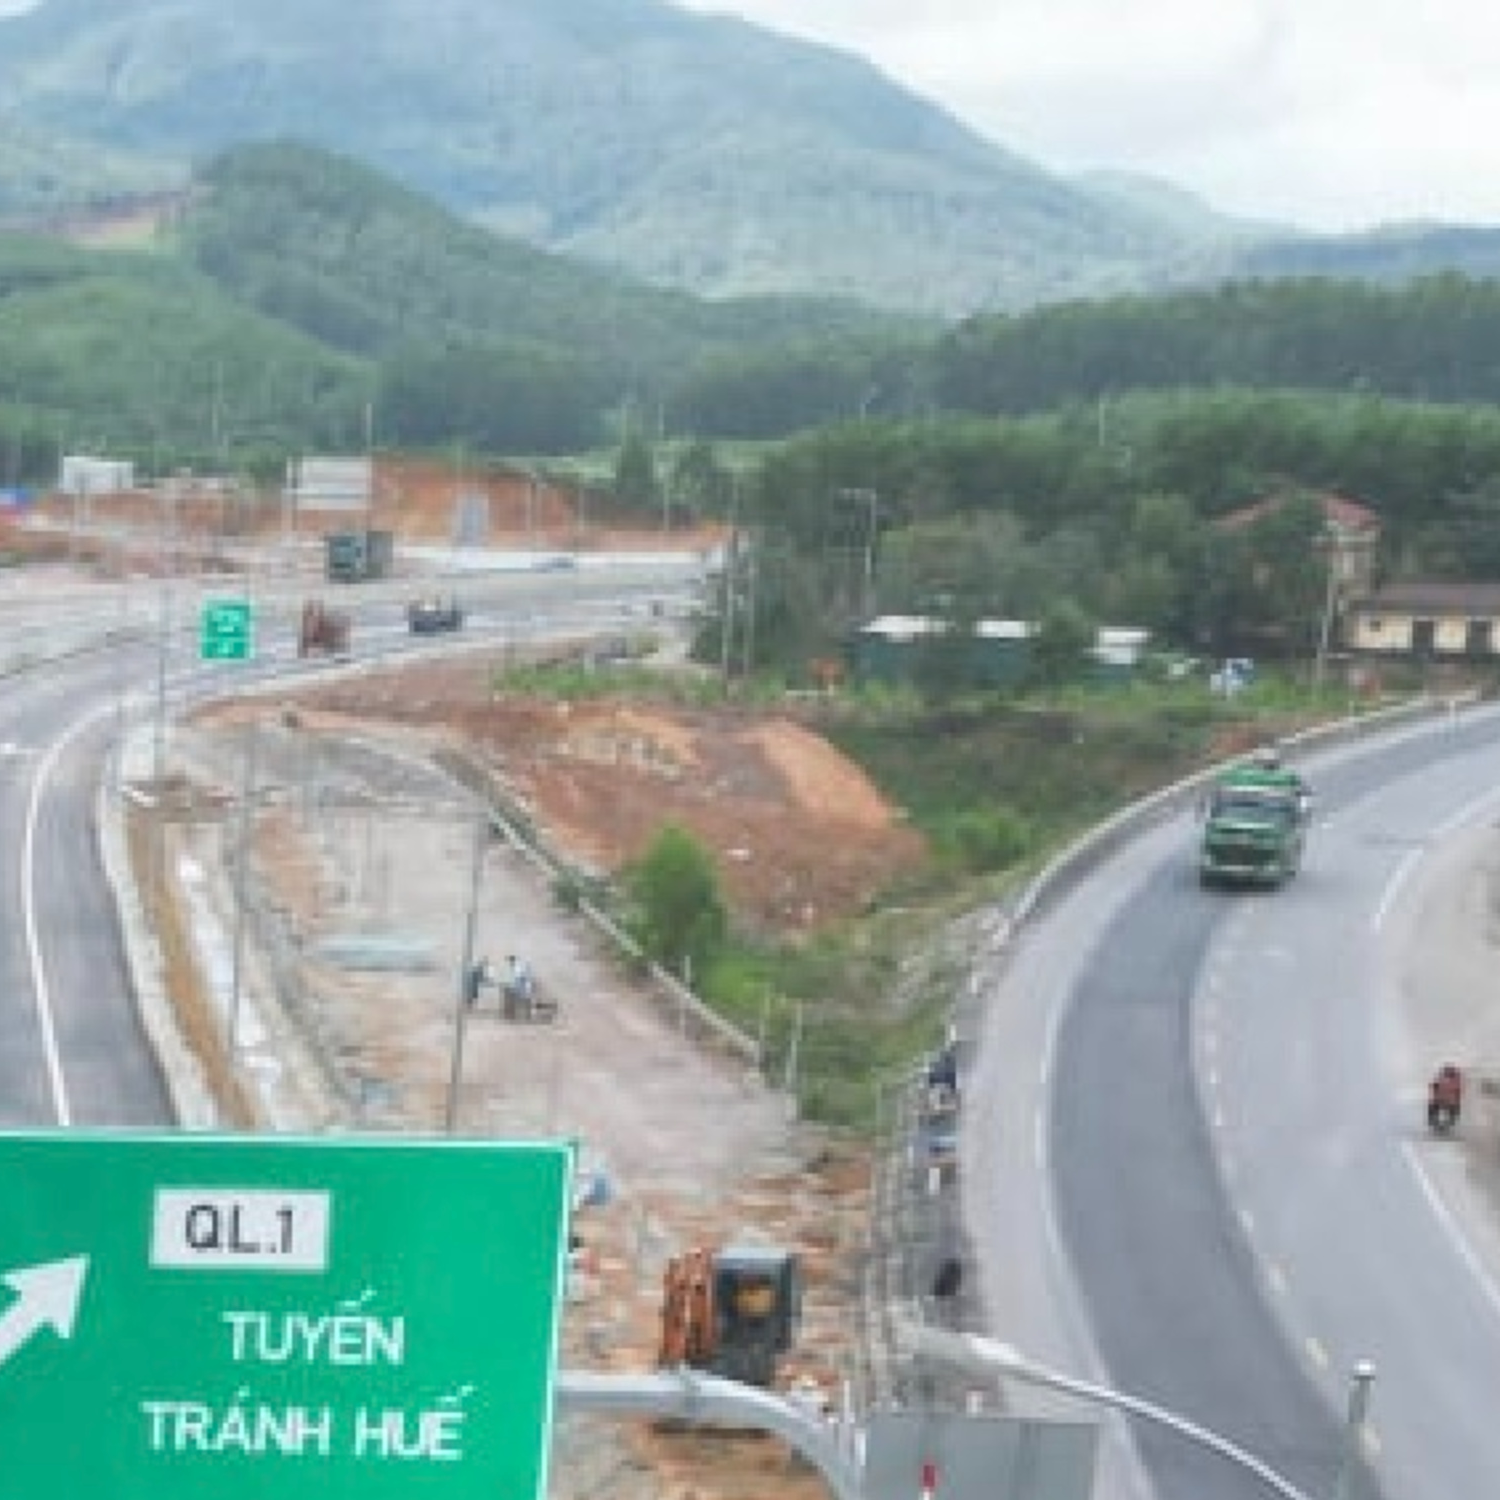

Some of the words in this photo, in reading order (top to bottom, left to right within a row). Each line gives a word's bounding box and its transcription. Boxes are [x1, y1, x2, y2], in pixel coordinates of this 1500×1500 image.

[184, 1204, 293, 1254] QL.1
[222, 1286, 405, 1365] TUYẾN
[141, 1386, 331, 1455] TRÁNH
[355, 1385, 476, 1461] HUẾ
